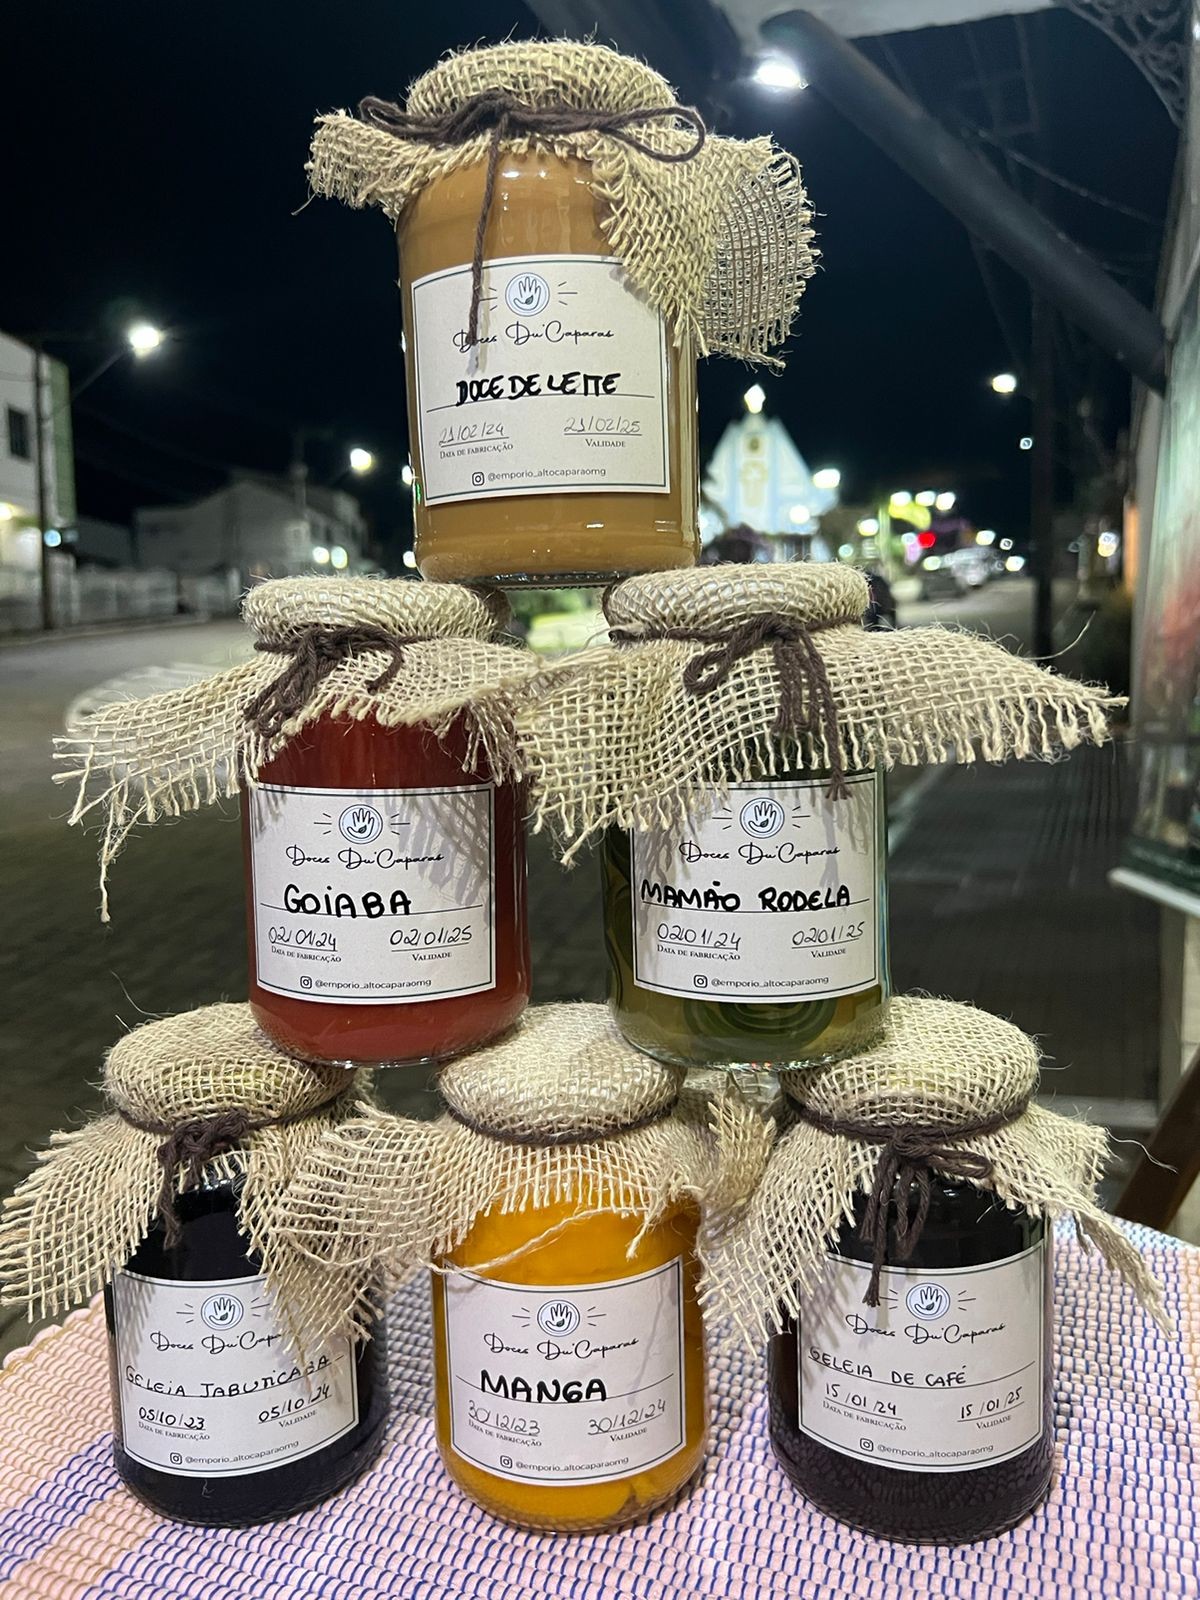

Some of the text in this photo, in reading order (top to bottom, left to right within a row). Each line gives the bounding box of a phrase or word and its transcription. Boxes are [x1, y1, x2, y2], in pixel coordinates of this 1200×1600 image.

[453, 329, 497, 353] Dces
[456, 372, 621, 406] DOCE DE LEITE
[439, 422, 504, 445] 21/02/24
[564, 416, 641, 433] 21/02/25
[488, 467, 606, 482] @emporio_altocaparaomg
[286, 845, 330, 866] Doces
[679, 841, 729, 862] Doces
[641, 879, 850, 911] MAMÃO RODELA
[315, 979, 431, 989] @emporio_altocaparaomg
[712, 976, 829, 988] @emporio_altocaparaomg
[846, 1314, 895, 1337] Doces
[150, 1331, 194, 1351] Doces
[484, 1333, 529, 1353] Doces
[809, 1347, 966, 1387] GELEIA DE CAFÉ
[481, 1370, 607, 1403] MANGA
[139, 1407, 205, 1429] 05/10/23
[469, 1400, 540, 1435] 30/12/23
[588, 1399, 665, 1436] 30/12/24
[186, 1440, 299, 1464] @emporio_altocaparaomg
[878, 1444, 993, 1458] @emporio_altocaparaomg
[516, 1456, 629, 1472] @emporio_altocaparaomg
